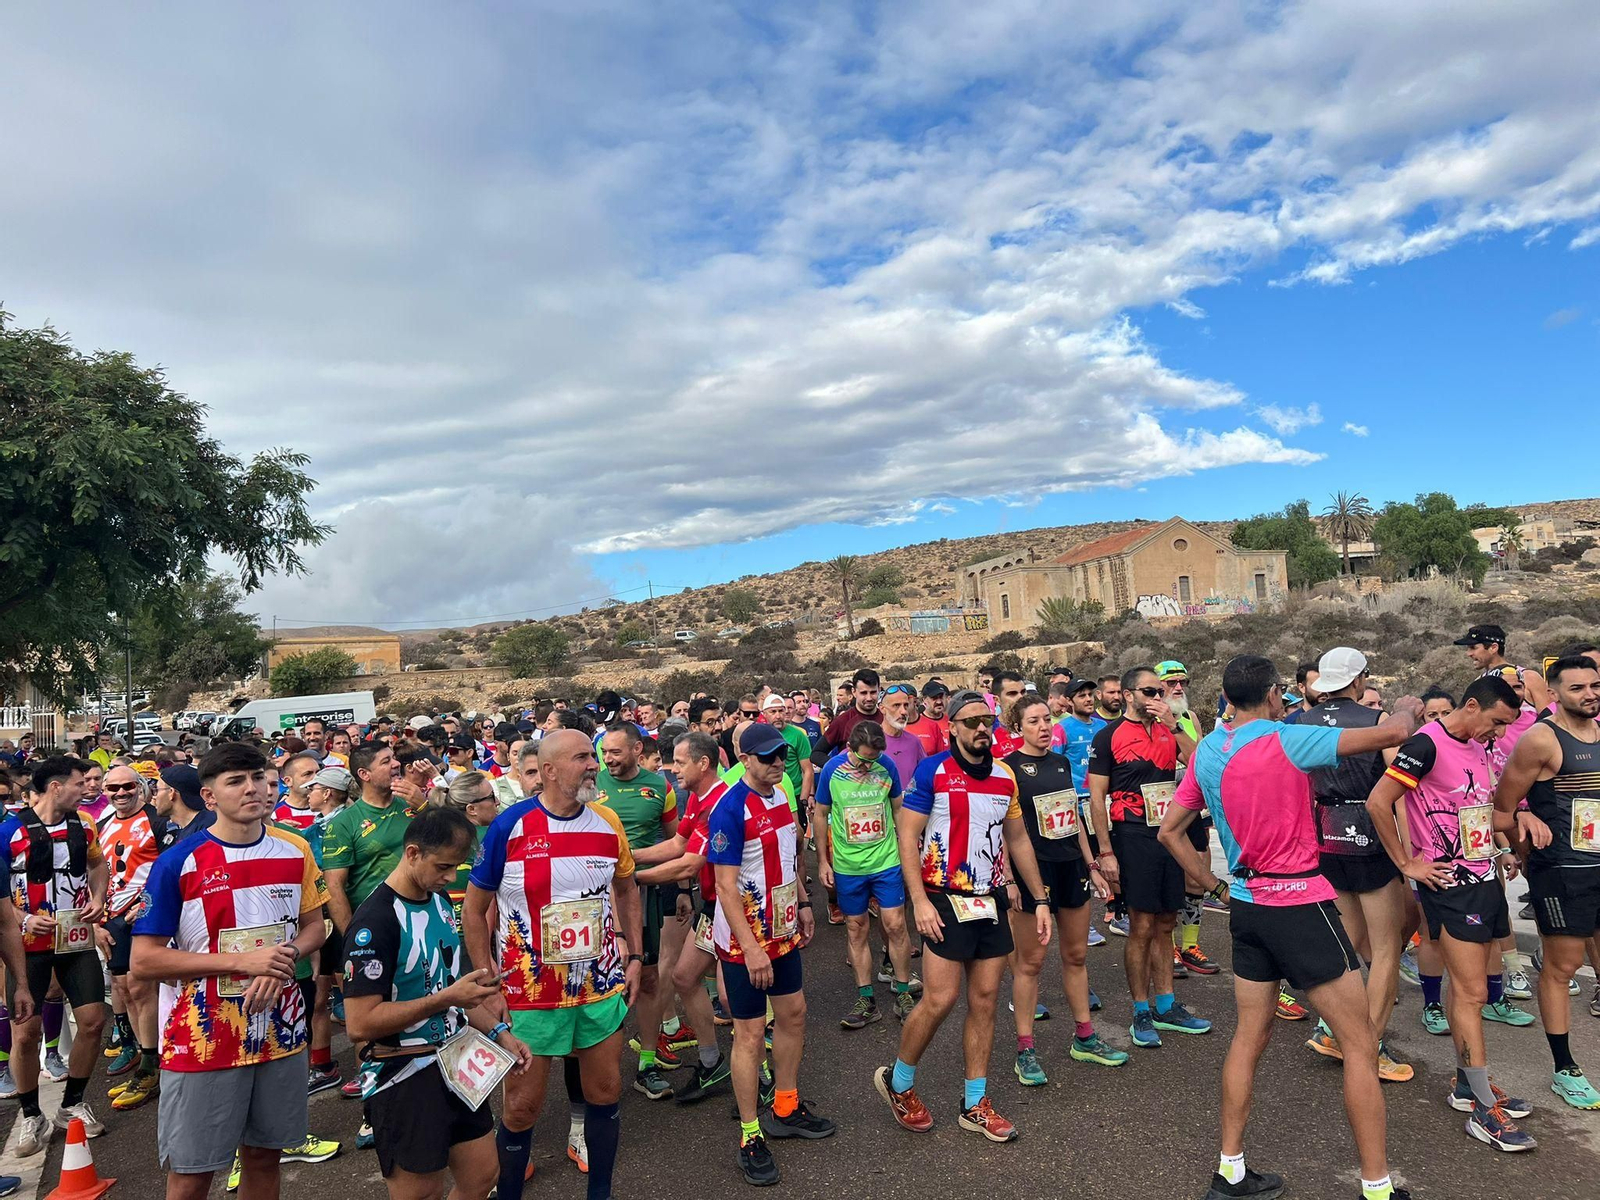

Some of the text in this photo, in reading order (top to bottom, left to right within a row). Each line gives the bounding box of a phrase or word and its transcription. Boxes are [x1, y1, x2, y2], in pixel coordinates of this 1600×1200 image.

[851, 790, 884, 798] SAKATA
[1448, 800, 1457, 808] 30
[1045, 809, 1076, 830] 172
[851, 820, 881, 836] 246
[1469, 828, 1492, 848] 24
[203, 884, 230, 895] ALMERÍA
[973, 898, 986, 909] 4
[69, 927, 88, 943] 69
[560, 926, 590, 949] 91
[457, 1048, 496, 1091] 113
